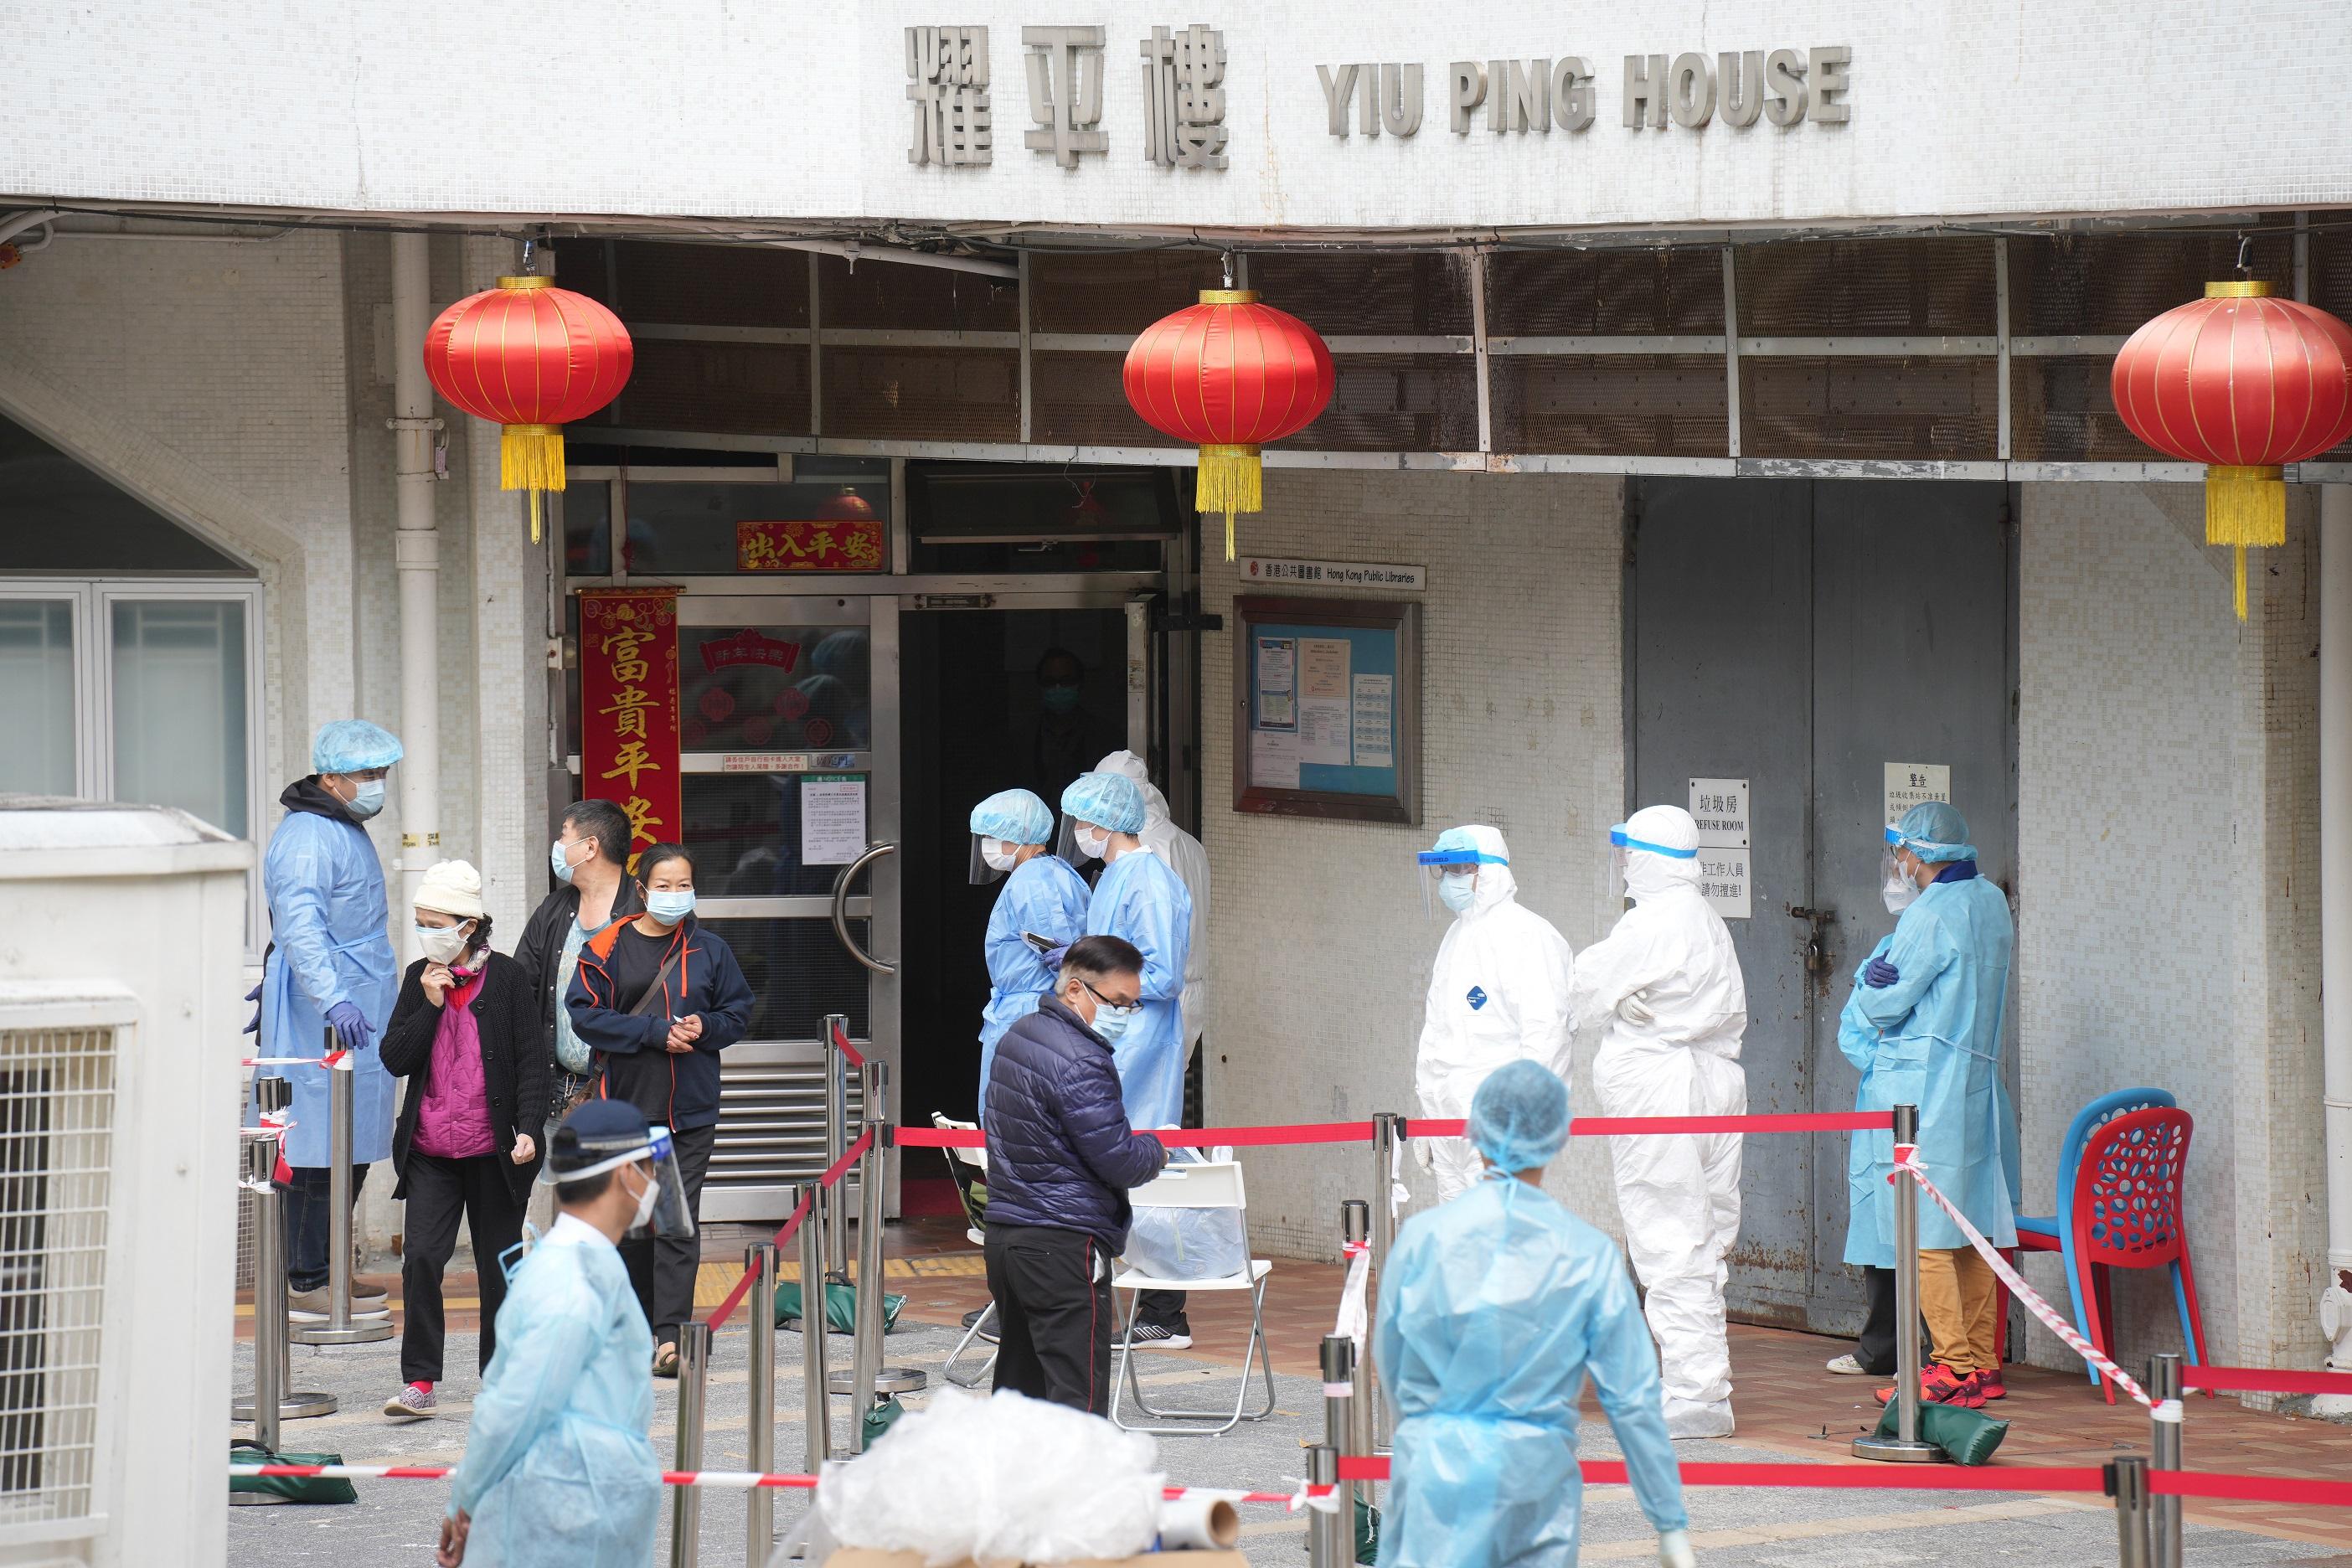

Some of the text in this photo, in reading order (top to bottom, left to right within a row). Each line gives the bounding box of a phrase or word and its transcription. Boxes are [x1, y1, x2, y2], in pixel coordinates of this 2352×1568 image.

[905, 24, 1229, 168] 耀平樓
[1315, 46, 1851, 137] YIU PING HOUSE
[747, 531, 872, 560] 出入平安
[1265, 564, 1415, 583] 香港公共圖書館 Hong Kong Public Libraries
[1910, 773, 1926, 787] 警告
[1700, 795, 1737, 813] 垃圾房
[1695, 820, 1744, 832] REFUSE ROOM
[1701, 883, 1741, 898] 請勿擅進!
